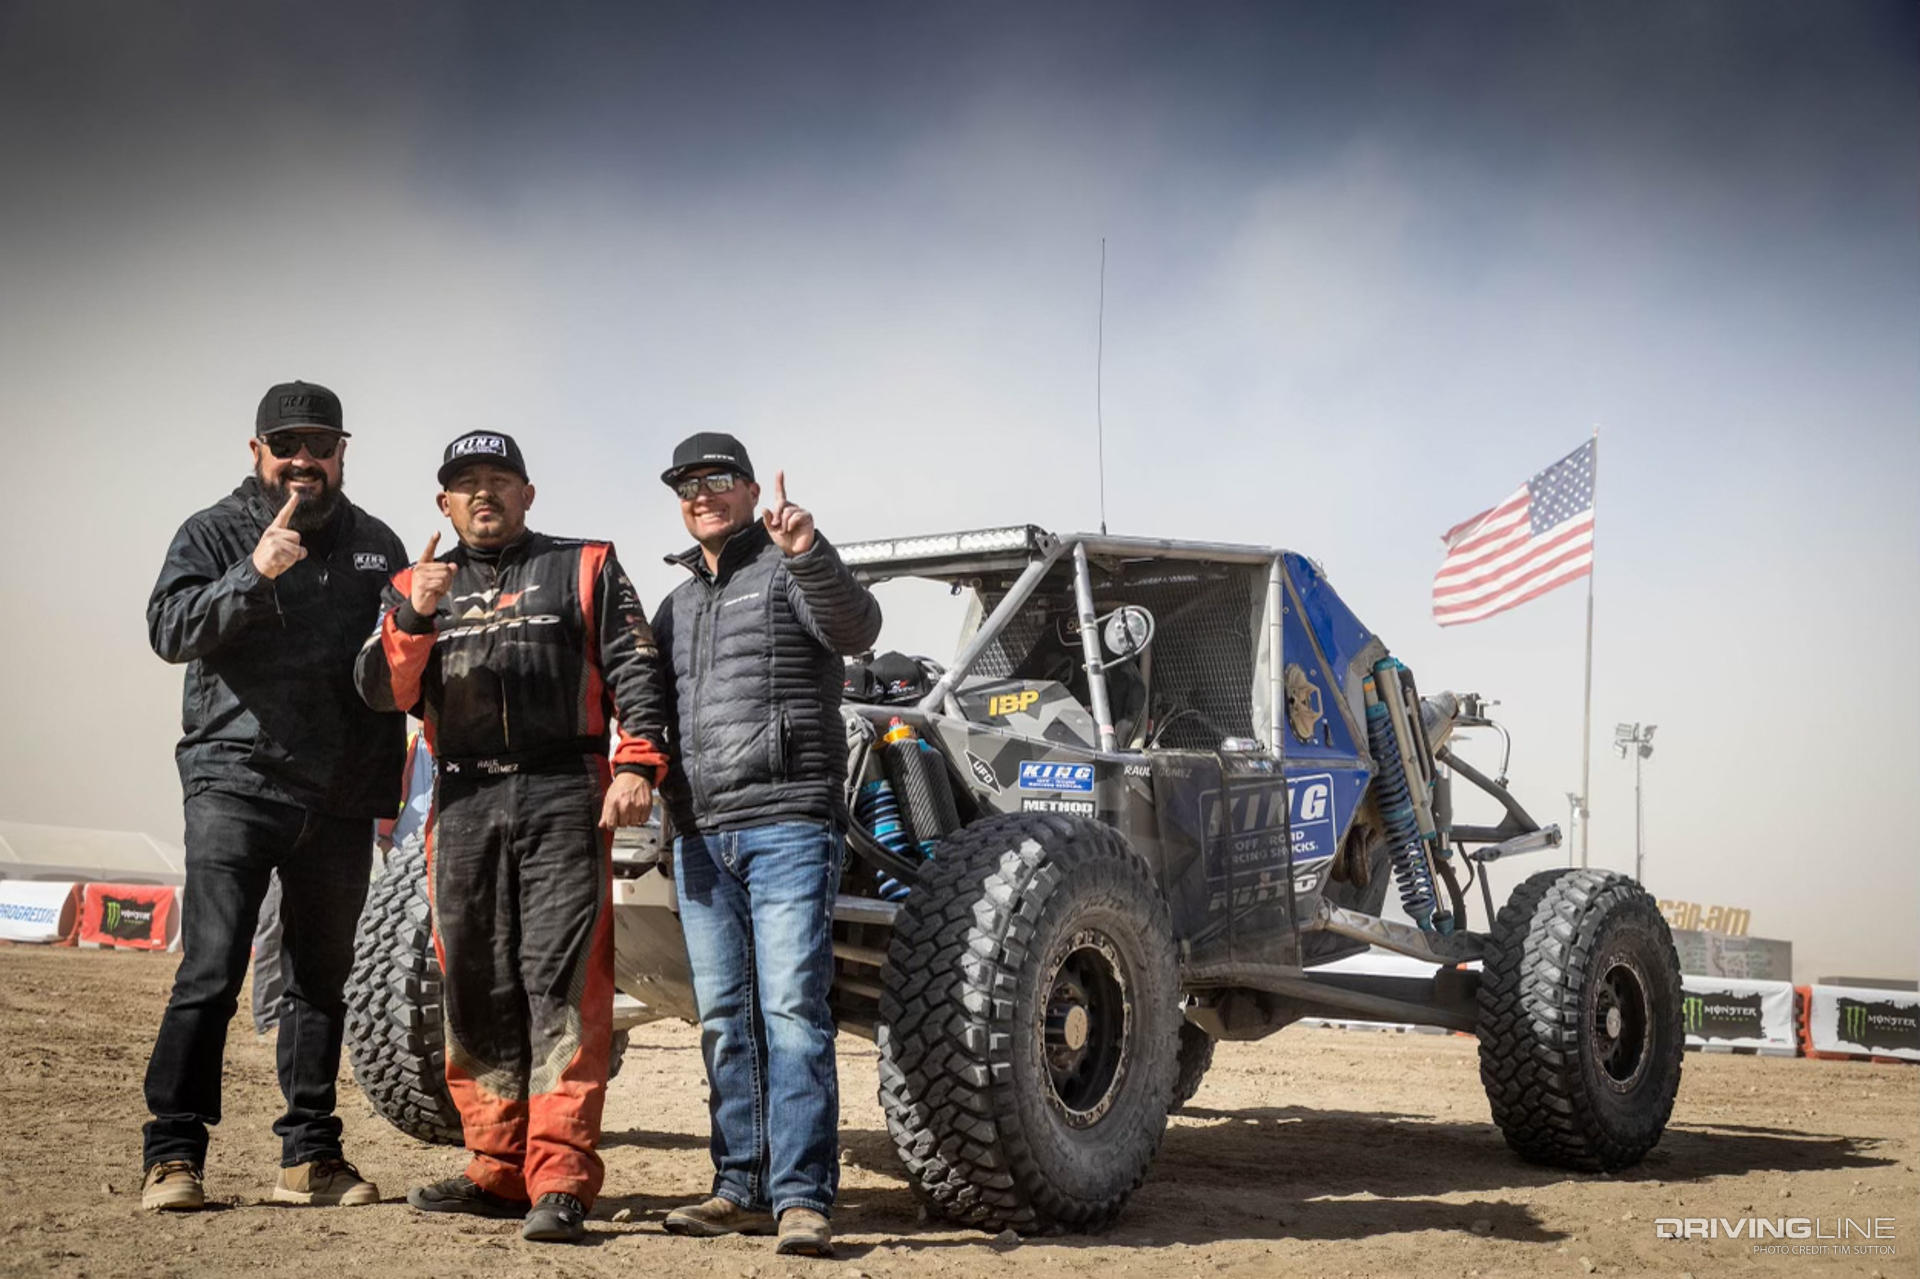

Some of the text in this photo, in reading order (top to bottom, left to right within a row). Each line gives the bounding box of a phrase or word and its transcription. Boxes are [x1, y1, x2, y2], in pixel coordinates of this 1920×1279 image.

[456, 438, 500, 454] KING
[356, 555, 385, 564] KING
[989, 690, 1039, 716] IBP
[488, 764, 518, 774] GOMEZ
[973, 761, 993, 784] UFO
[1022, 764, 1092, 781] KING
[1124, 764, 1151, 777] RAUL
[1022, 799, 1094, 813] METHOD
[1207, 784, 1328, 838] KING
[1235, 838, 1258, 850] OFF
[1223, 850, 1268, 865] ACING
[1704, 1005, 1757, 1017] MONSTER
[1867, 1014, 1916, 1028] MONSTER
